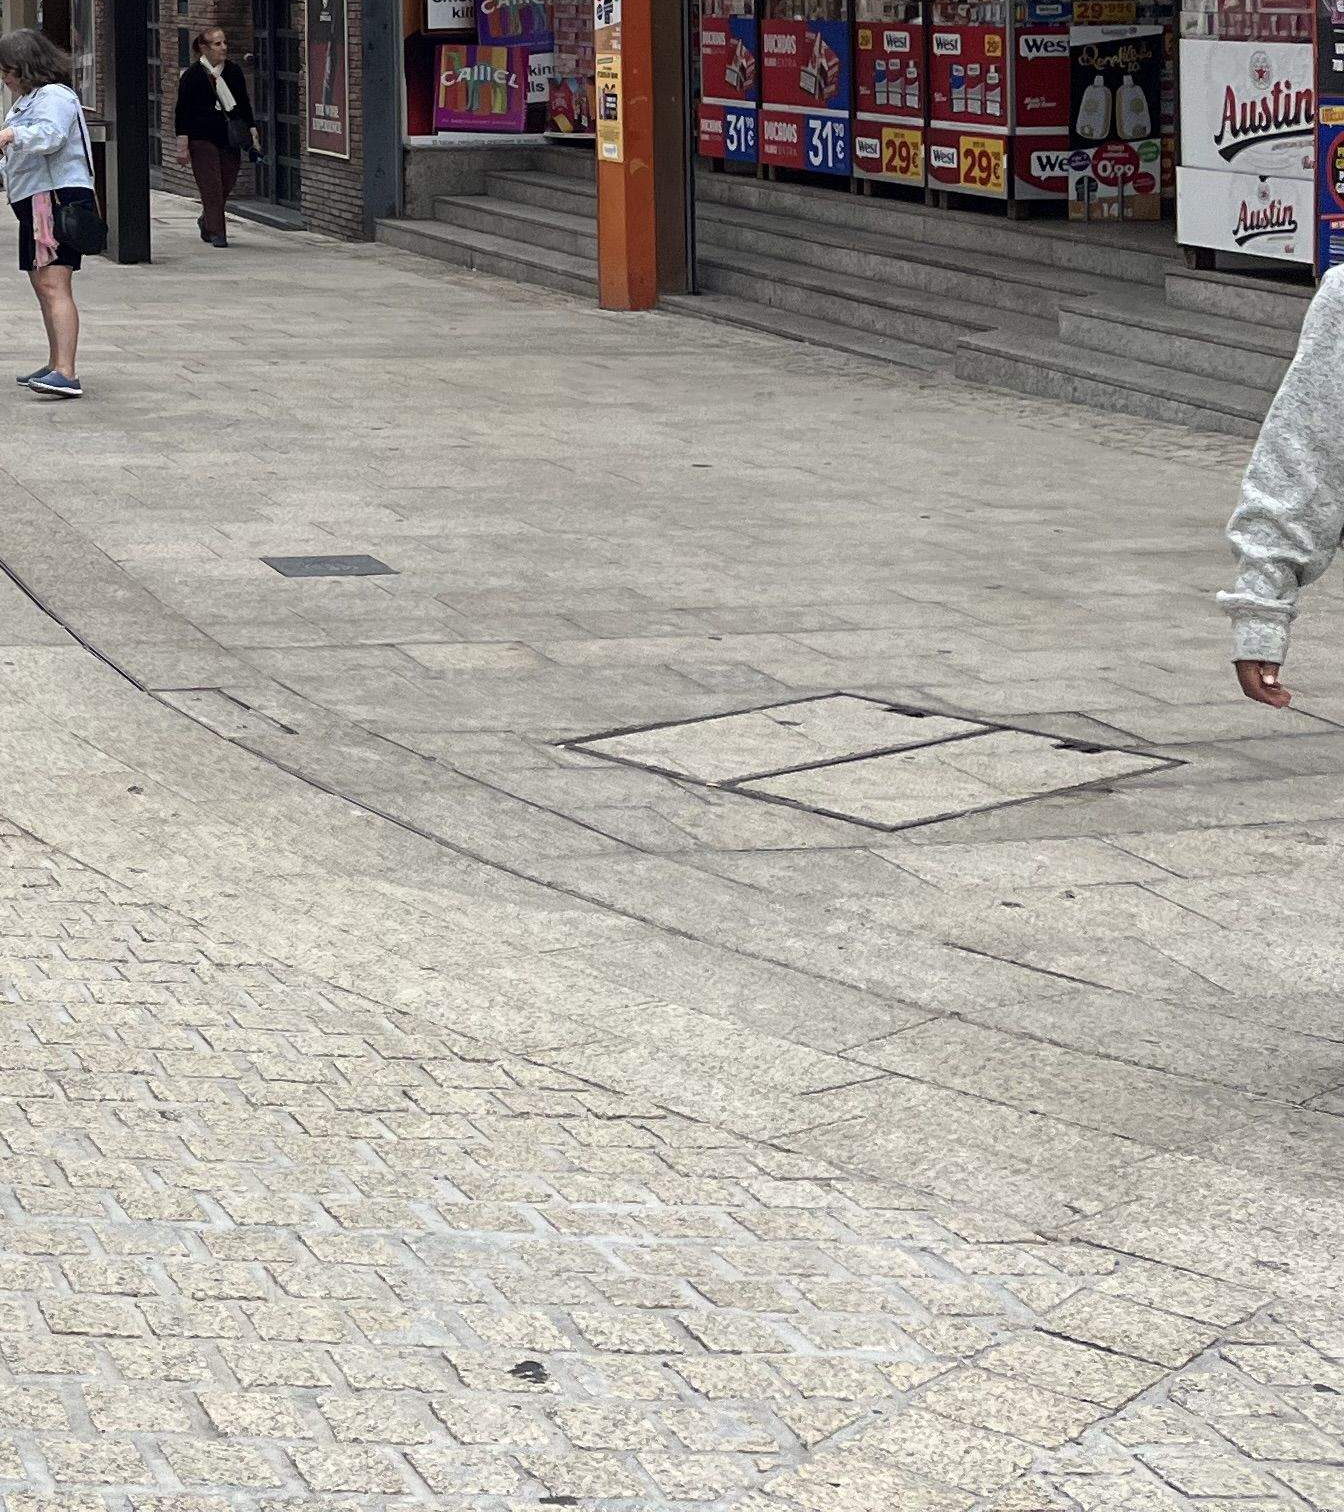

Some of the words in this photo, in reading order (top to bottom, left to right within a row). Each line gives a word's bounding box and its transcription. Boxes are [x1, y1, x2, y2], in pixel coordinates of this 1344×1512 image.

[452, 6, 473, 19] kill
[886, 33, 907, 48] West
[936, 36, 958, 51] West
[1024, 38, 1069, 54] Wes
[440, 65, 519, 89] CAMEL
[1213, 80, 1315, 146] Austin
[726, 114, 746, 153] 31
[809, 119, 833, 168] 31
[858, 139, 878, 155] West
[885, 139, 911, 175] 29
[933, 149, 955, 165] West
[963, 148, 992, 186] 29
[1036, 155, 1069, 173] We
[1232, 199, 1297, 236] Austin
